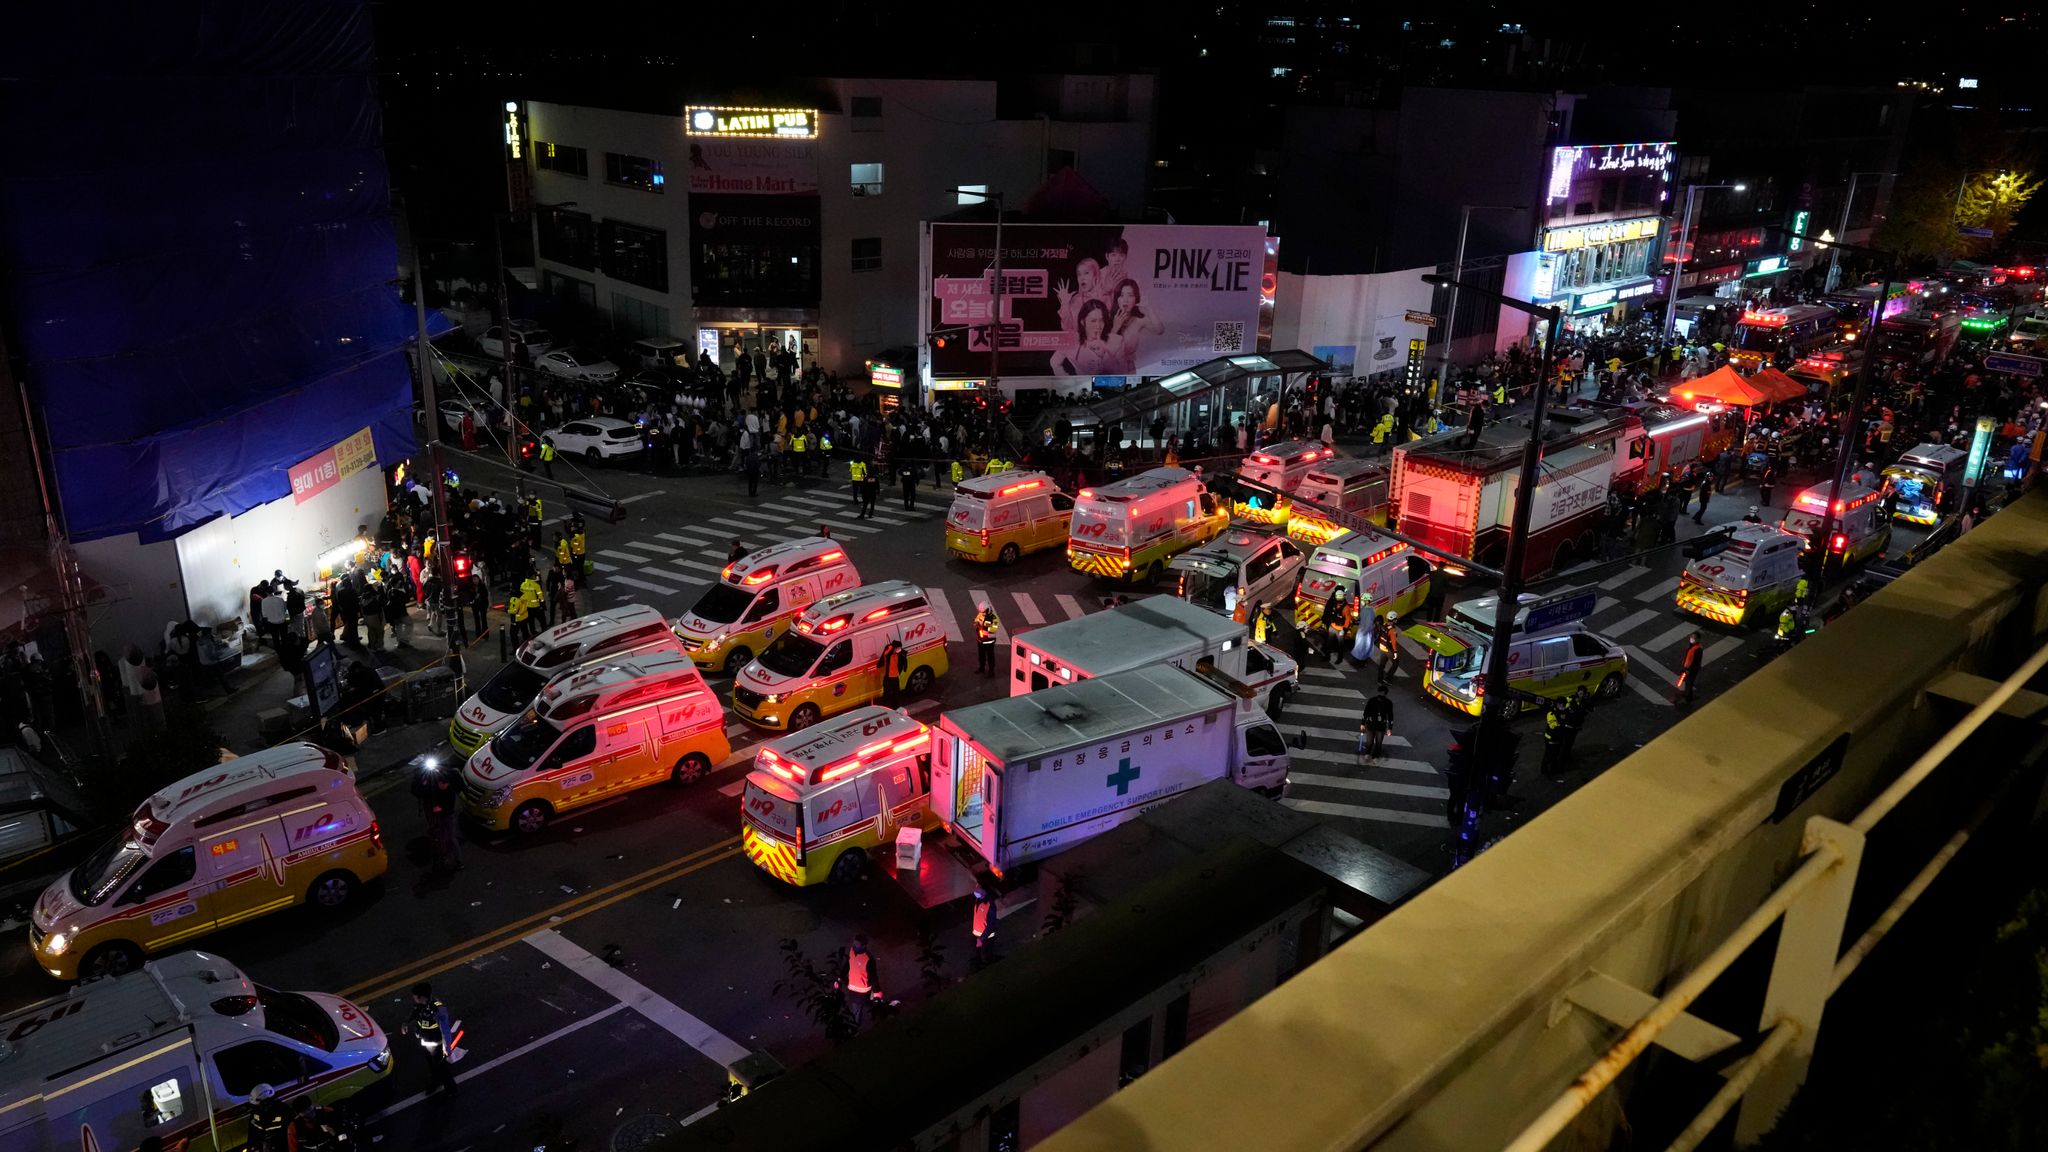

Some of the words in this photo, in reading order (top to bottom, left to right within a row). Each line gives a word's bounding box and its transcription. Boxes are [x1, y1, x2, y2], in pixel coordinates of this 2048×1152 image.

[717, 115, 770, 132] LATIN
[773, 113, 808, 128] PUB
[736, 143, 777, 159] YOUNG
[709, 175, 753, 191] Home
[756, 176, 796, 191] Mart
[719, 215, 739, 225] OFF
[742, 216, 763, 227] THE
[766, 217, 811, 228] RECORD
[948, 248, 975, 259] 사랑을
[1010, 248, 1038, 259] 하나의
[1040, 248, 1068, 259] 거짓말
[1217, 249, 1251, 260] 핑크라이
[1154, 249, 1212, 279] PINK
[1210, 261, 1250, 291] LIE
[294, 471, 314, 495] 임대
[1077, 523, 1106, 537] 119
[1149, 518, 1163, 533] 119
[1698, 564, 1725, 576] 119
[825, 573, 844, 589] 119
[905, 623, 926, 641] 119
[667, 703, 696, 725] 119
[180, 773, 229, 800] 119
[750, 798, 775, 816] 119
[817, 799, 843, 823] 119
[1041, 815, 1072, 831] MOBILE
[1075, 802, 1124, 821] EMERGENCY
[1127, 790, 1162, 805] SUPPORT
[1164, 782, 1183, 795] UNIT
[295, 813, 334, 841] 119
[297, 842, 338, 859] AMBULANCE
